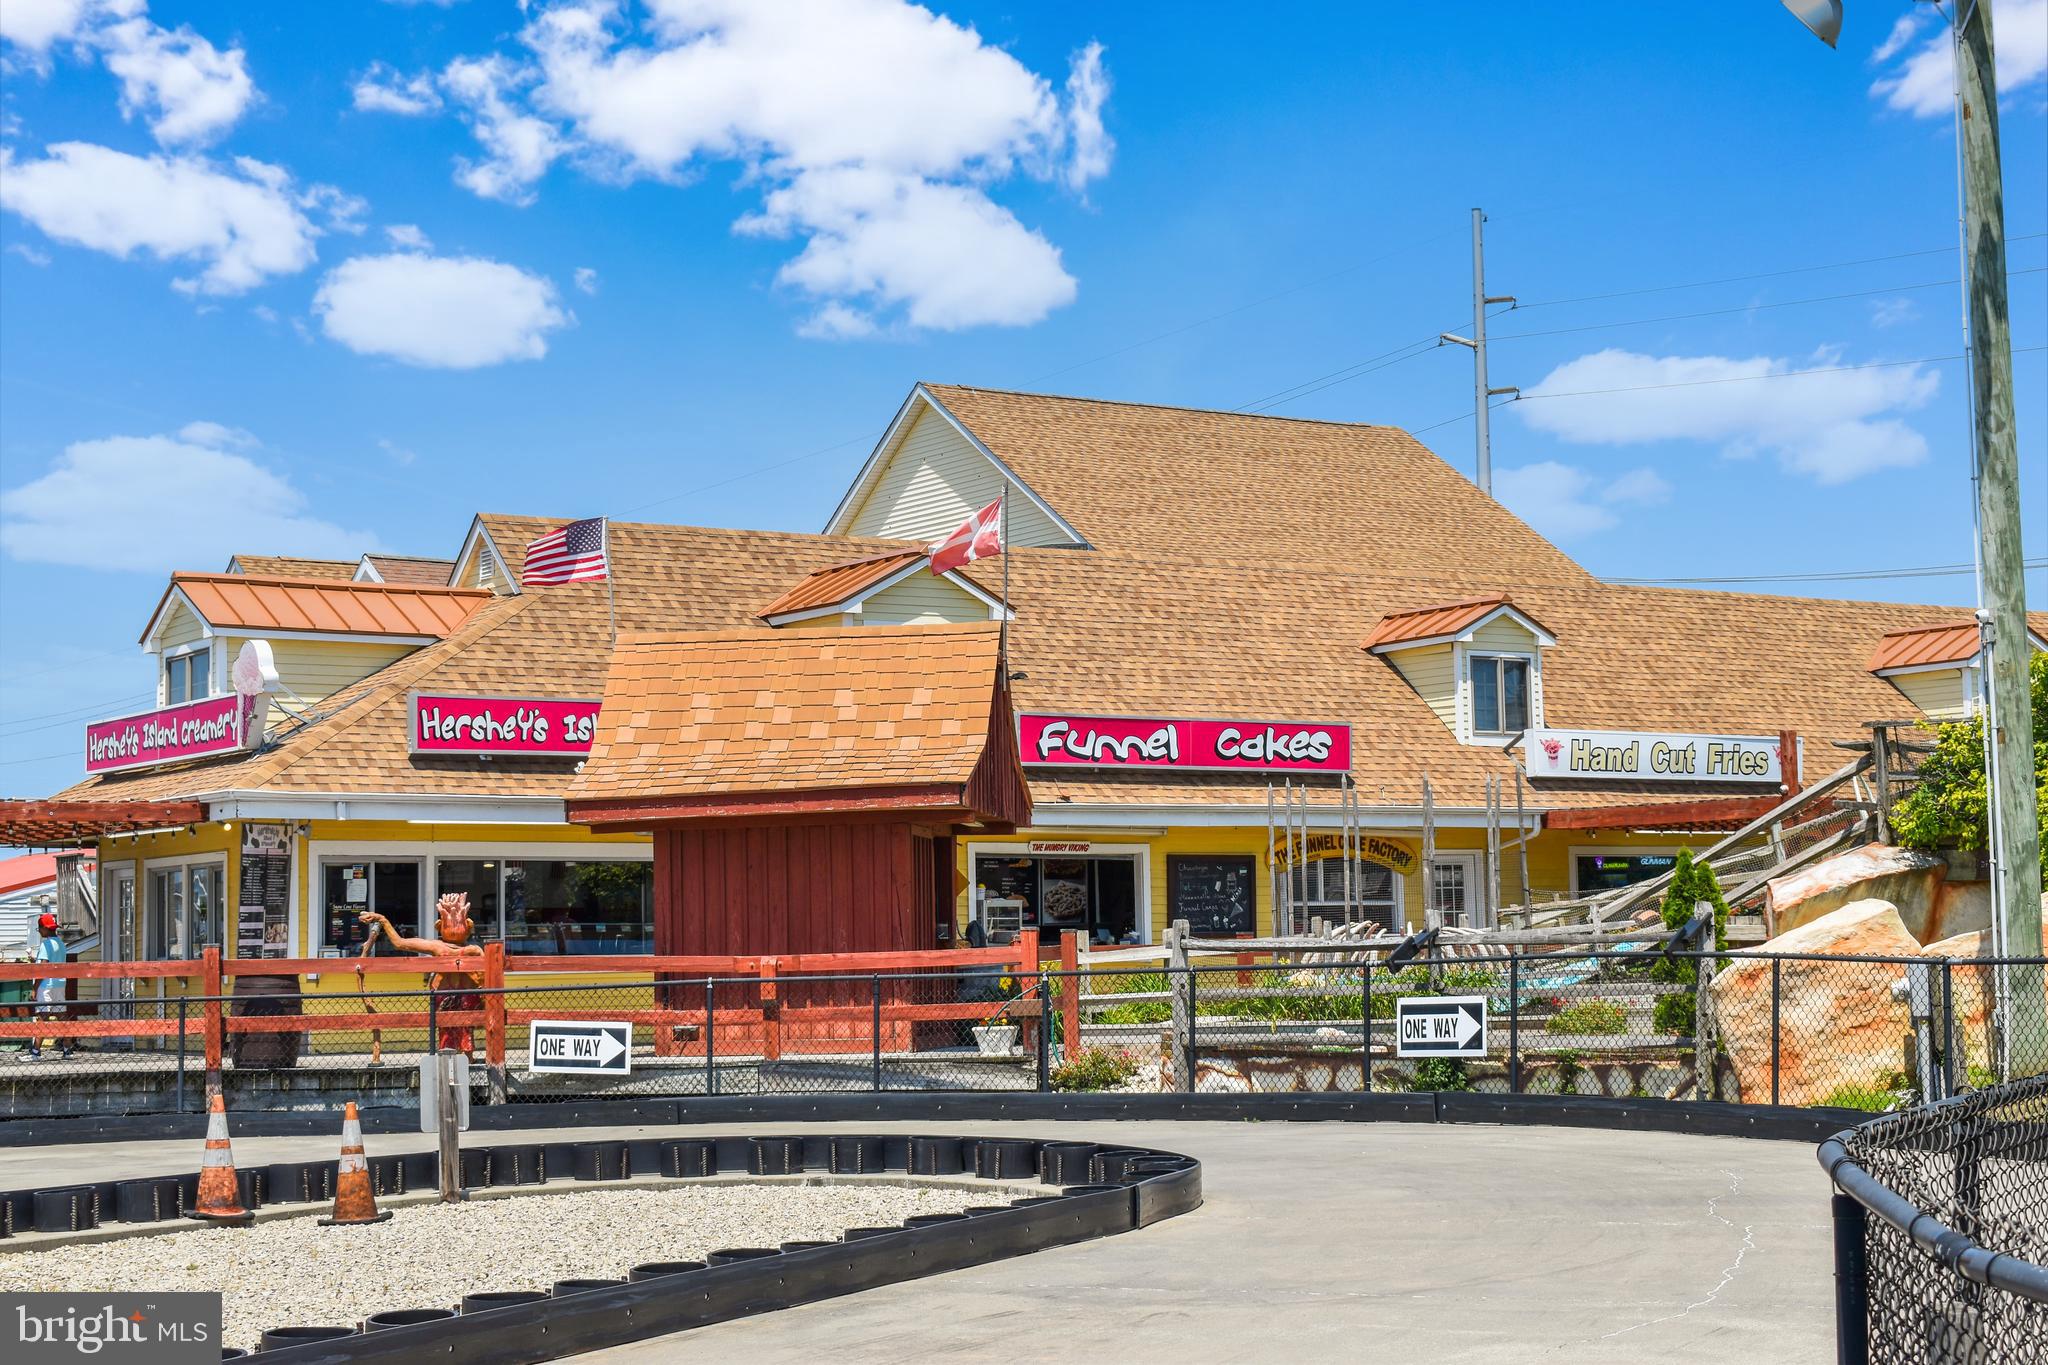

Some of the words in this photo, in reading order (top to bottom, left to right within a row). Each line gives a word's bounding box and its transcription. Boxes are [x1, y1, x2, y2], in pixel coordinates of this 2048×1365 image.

[142, 718, 178, 749] Island
[1037, 720, 1179, 763] Funnel
[1215, 726, 1333, 762] Cakes
[1570, 739, 1639, 773] Hand
[1650, 740, 1697, 774] Cut
[1706, 742, 1769, 775] Fries
[1032, 843, 1044, 852] THE
[1044, 843, 1068, 852] HUNGRY
[1068, 843, 1090, 853] VIKING
[1368, 838, 1413, 867] FACTORY
[1405, 1018, 1427, 1039] ONE
[1433, 1017, 1458, 1038] WAY
[540, 1038, 565, 1056] ONE
[573, 1038, 601, 1057] WAY
